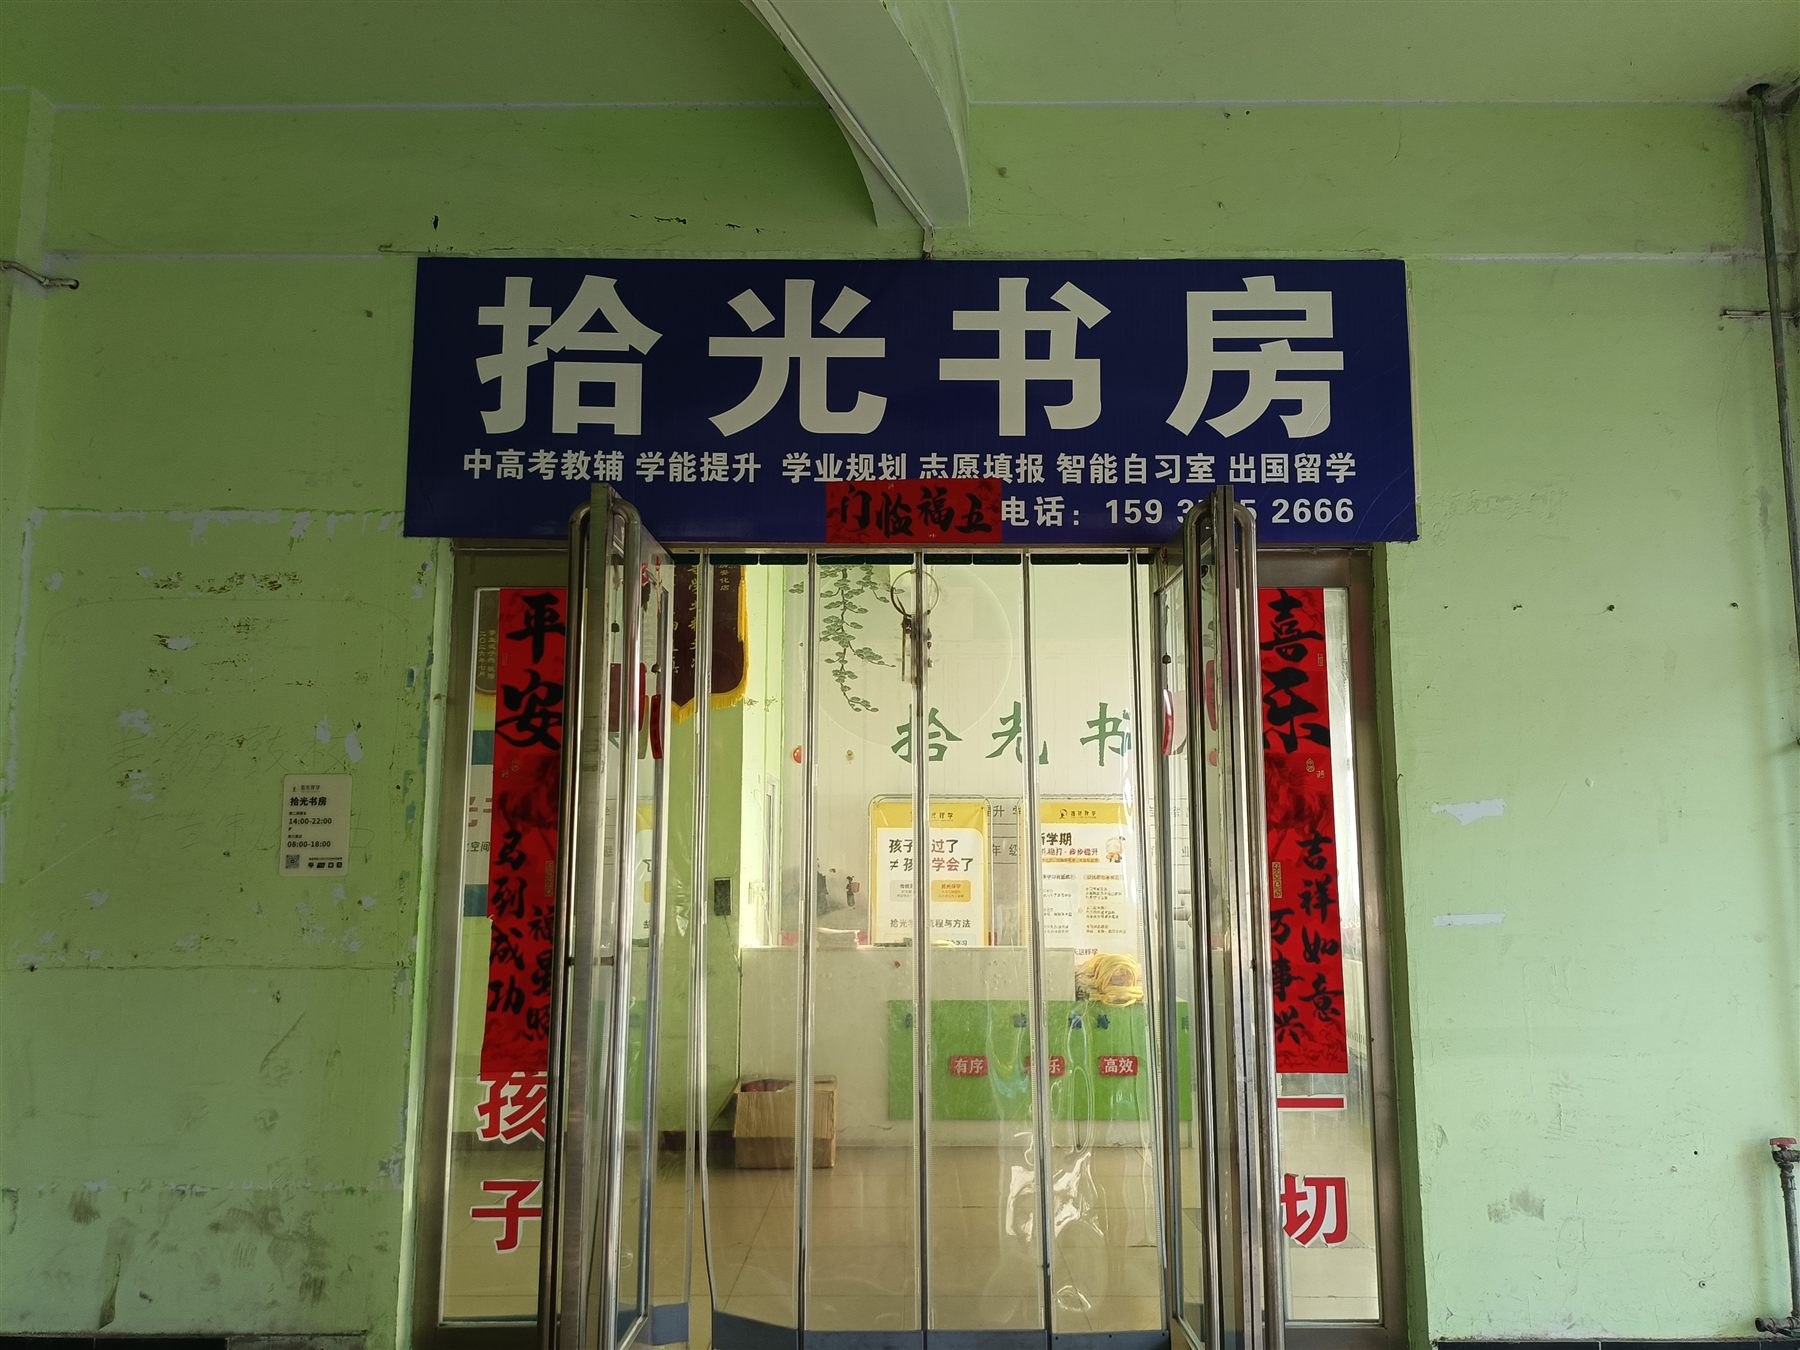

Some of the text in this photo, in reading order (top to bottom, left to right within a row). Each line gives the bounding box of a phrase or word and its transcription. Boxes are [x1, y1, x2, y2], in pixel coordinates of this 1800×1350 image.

[475, 274, 1344, 438] 拾光书房
[463, 448, 1356, 484] 中高考教辅 学能提升 学业规划 志愿填报 智能自习室 出国留学
[1105, 498, 1163, 525] 159
[1271, 498, 1355, 524] 2666
[496, 592, 567, 751] 平安
[891, 700, 1187, 767] 拾光书
[290, 796, 327, 806] 拾光书房
[287, 840, 331, 848] 08:00-18:00
[467, 841, 491, 853] 空间
[889, 838, 959, 853] 孩子过了
[488, 828, 528, 1015] 马到成功
[1297, 829, 1344, 1022] 吉祥如意
[954, 1058, 984, 1074] 有序
[1104, 1058, 1134, 1074] 高效
[471, 1071, 548, 1254] 孩子
[1276, 1096, 1348, 1247] 一切
